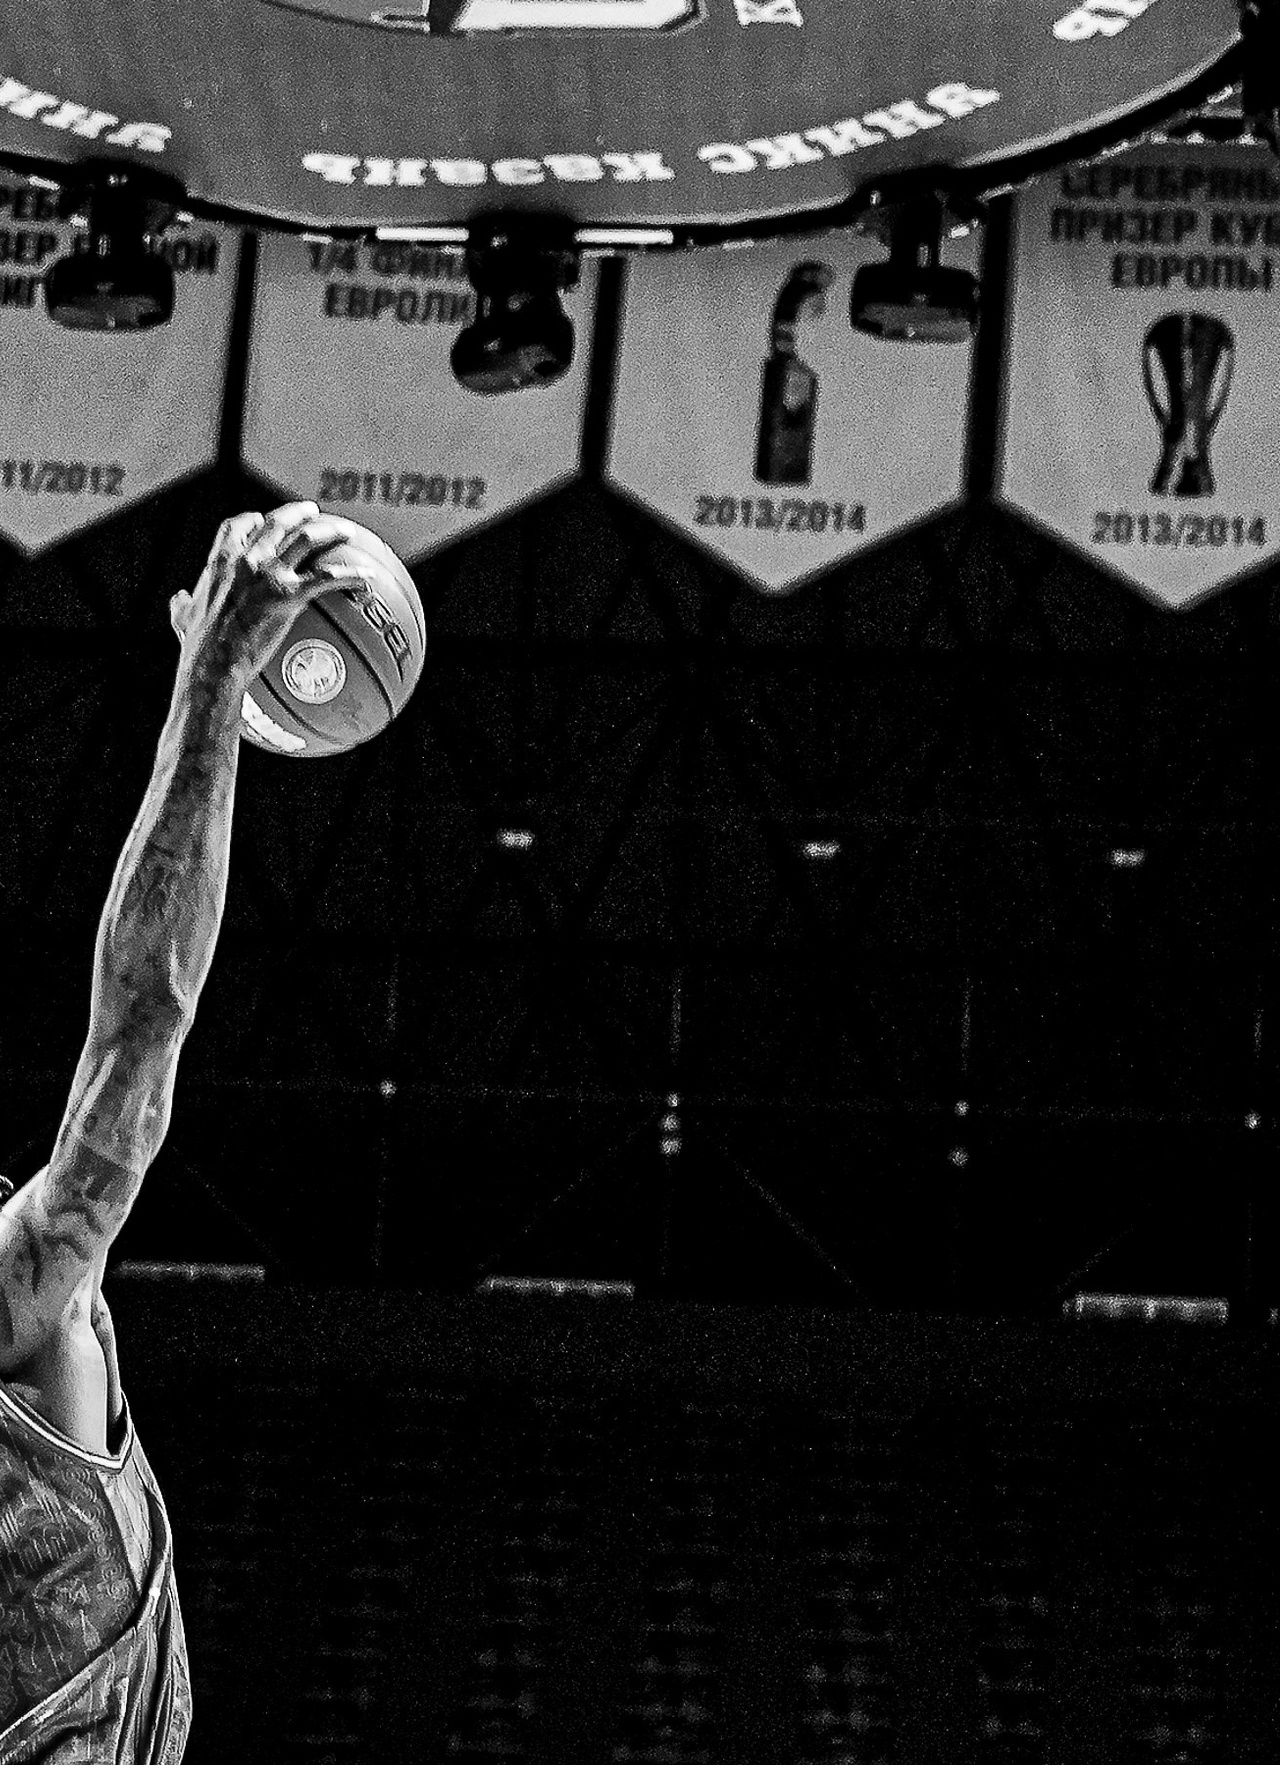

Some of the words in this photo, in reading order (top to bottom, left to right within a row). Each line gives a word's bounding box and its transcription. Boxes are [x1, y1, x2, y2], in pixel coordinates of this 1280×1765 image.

[1111, 253, 1273, 292] ЕВРОПЫ
[319, 468, 488, 510] 2011/2012
[693, 495, 867, 535] 2013/2014
[1091, 511, 1270, 547] 2013/2014
